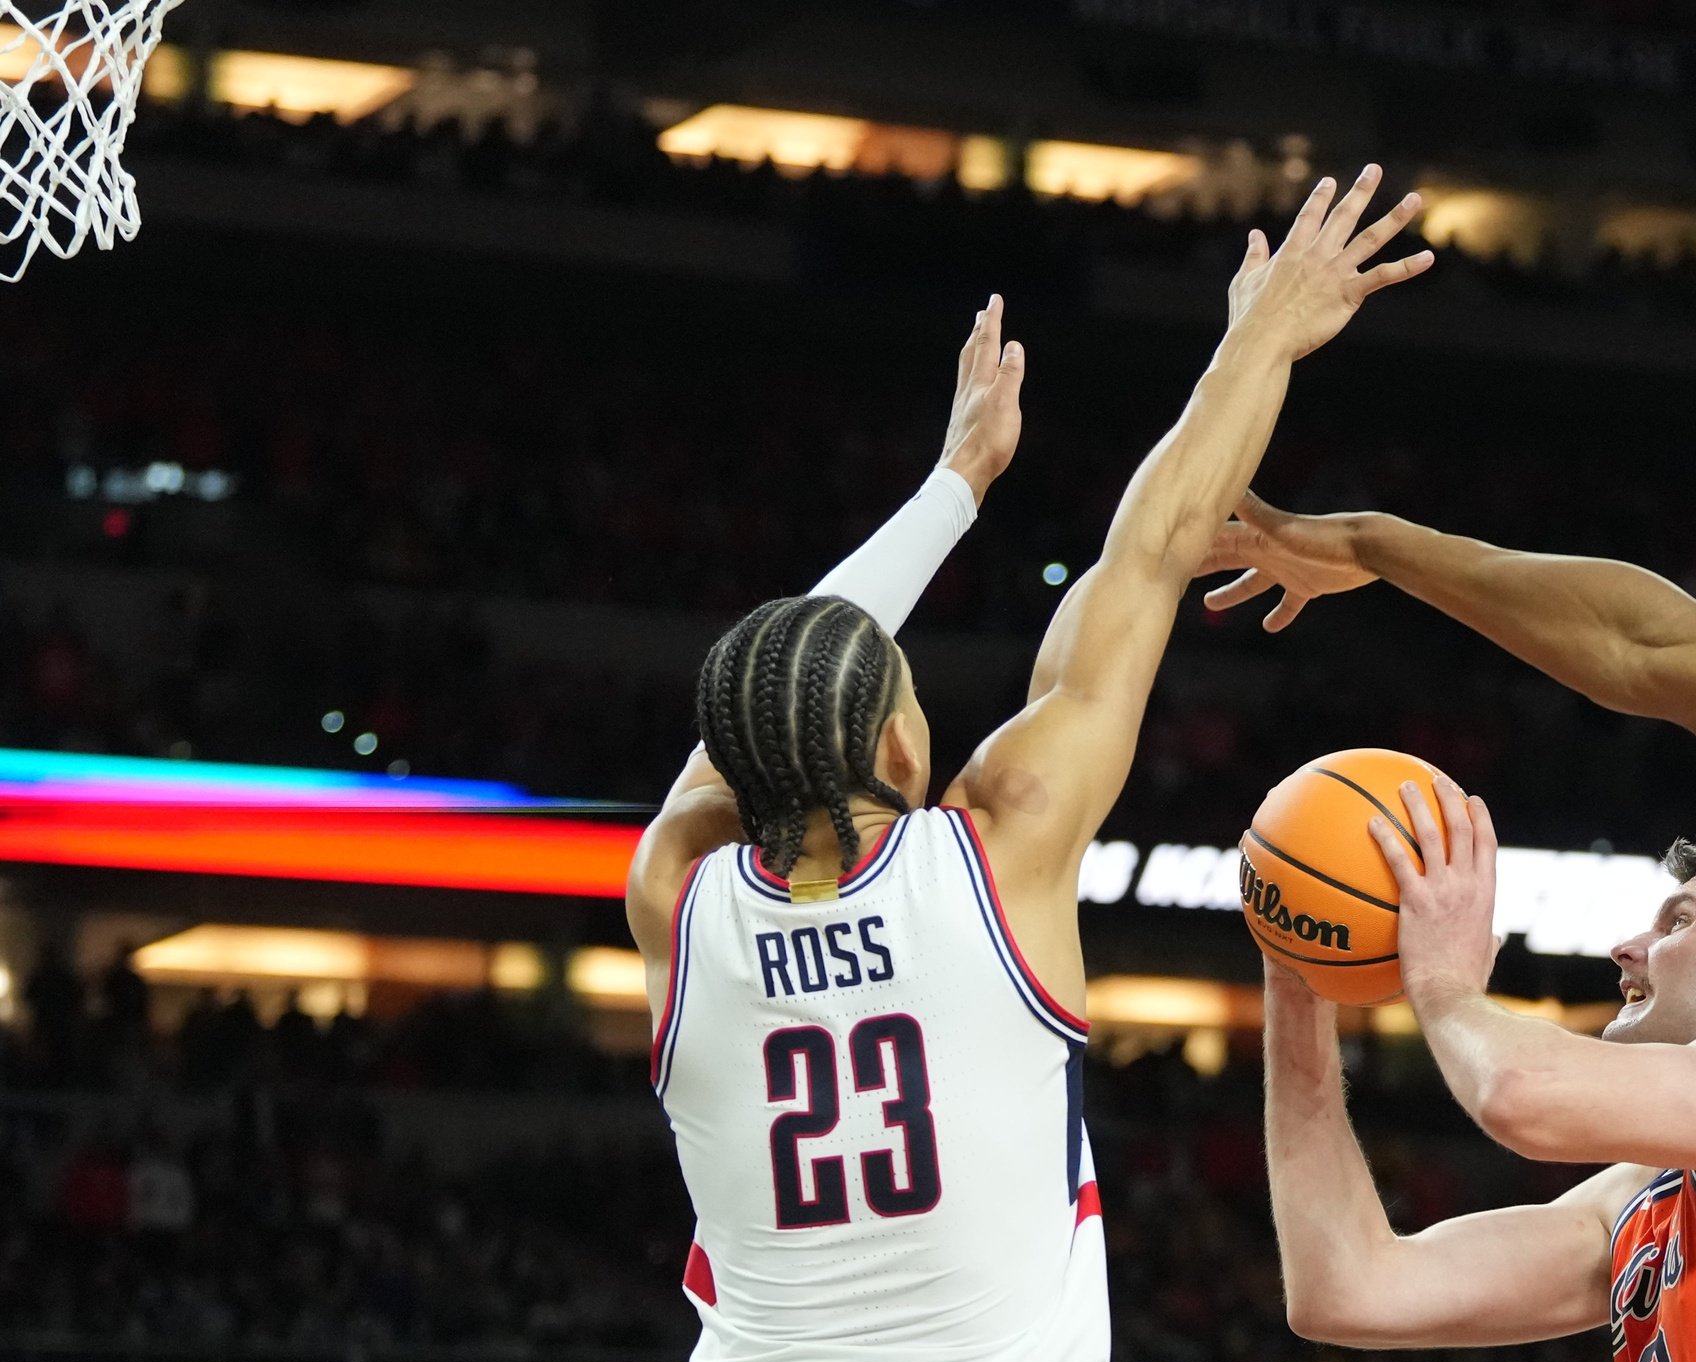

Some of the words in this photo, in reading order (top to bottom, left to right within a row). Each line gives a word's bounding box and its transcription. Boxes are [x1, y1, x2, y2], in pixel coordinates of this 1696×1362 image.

[1240, 847, 1352, 952] Wilson
[756, 915, 894, 998] ROSS
[763, 1012, 942, 1230] 23
